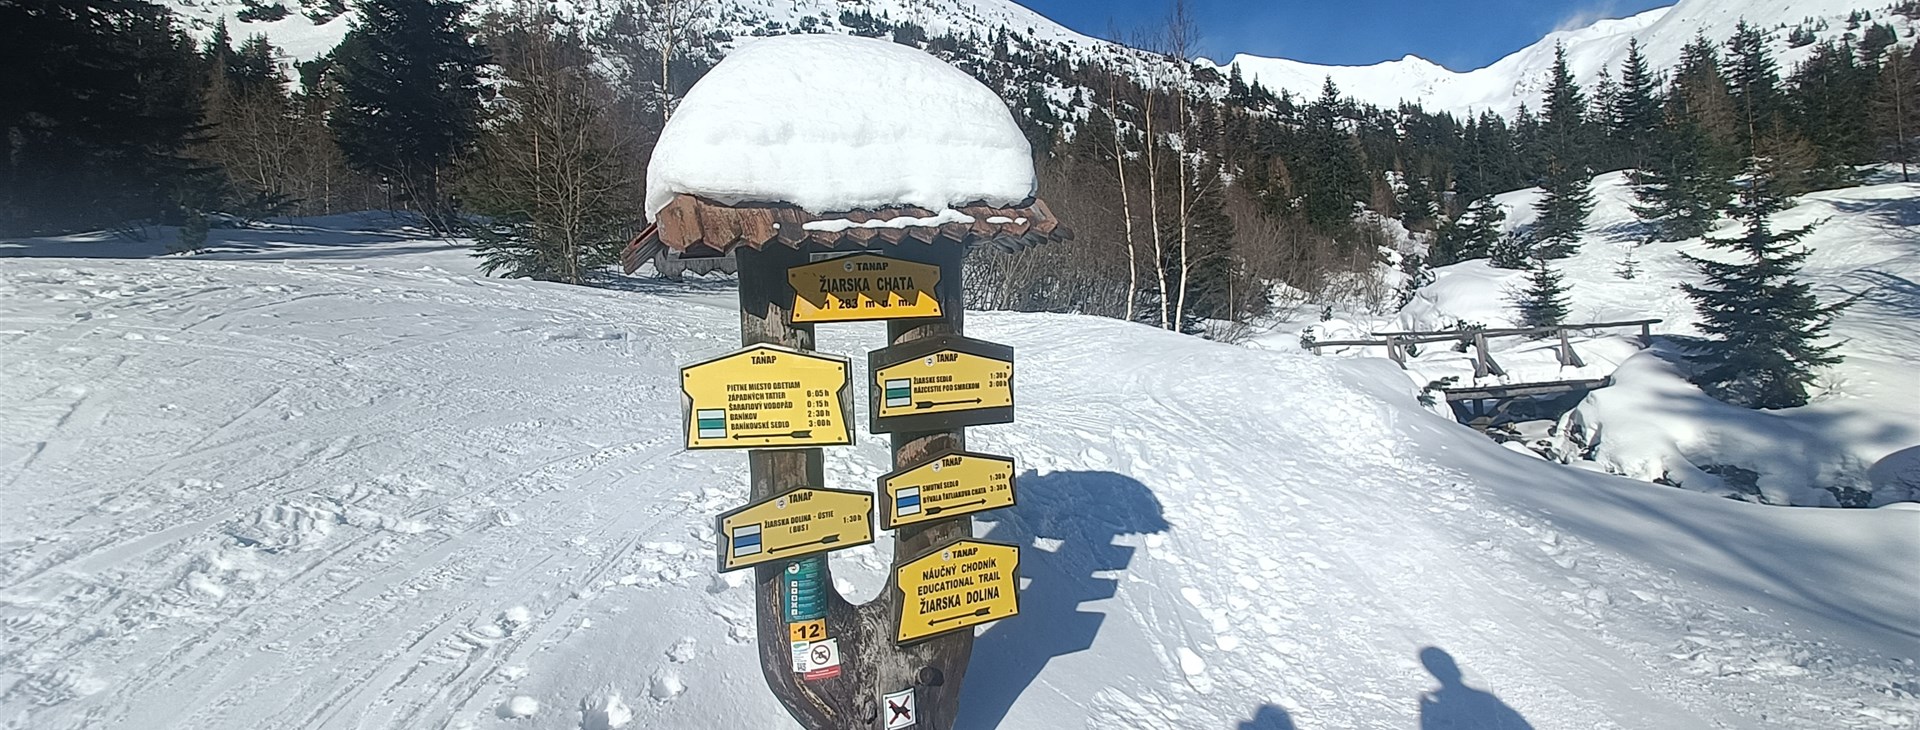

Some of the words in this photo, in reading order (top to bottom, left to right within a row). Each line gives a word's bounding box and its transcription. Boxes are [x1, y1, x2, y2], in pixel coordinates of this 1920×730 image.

[856, 262, 889, 271] TANAP
[819, 275, 870, 293] ŽIARSKA
[876, 276, 914, 291] CHATA
[825, 299, 830, 310] 1
[838, 298, 858, 309] 283
[865, 299, 875, 308] m
[751, 356, 777, 364] TANAP
[936, 353, 958, 363] TANAP
[913, 376, 936, 385] ŽIARSKE
[936, 375, 953, 383] SEDLO
[726, 383, 748, 392] PIETNE
[748, 382, 772, 391] MIESTO
[942, 384, 954, 392] POD
[728, 392, 765, 402] ZÁPADNÝCH
[765, 391, 786, 400] TATIER
[763, 400, 793, 410] VODOPÁD
[729, 412, 758, 421] BANÍKOV
[730, 421, 770, 431] BANÍKOVSKÉ
[770, 420, 790, 429] SEDLO
[942, 457, 962, 467] TANAP
[944, 480, 959, 489] SEDLO
[788, 491, 813, 504] TANAP
[764, 517, 790, 529] ŽIARSKA
[790, 514, 811, 524] DOLINA
[952, 547, 979, 559] TANAP
[922, 563, 957, 581] NÁUČNÝ
[961, 557, 997, 574] CHODNÍK
[917, 576, 975, 597] EDUCATIONAL
[978, 571, 1001, 583] TRAIL
[919, 594, 961, 615] ŽIARSKA
[966, 586, 1000, 605] DOLINA
[797, 623, 821, 639] 12
